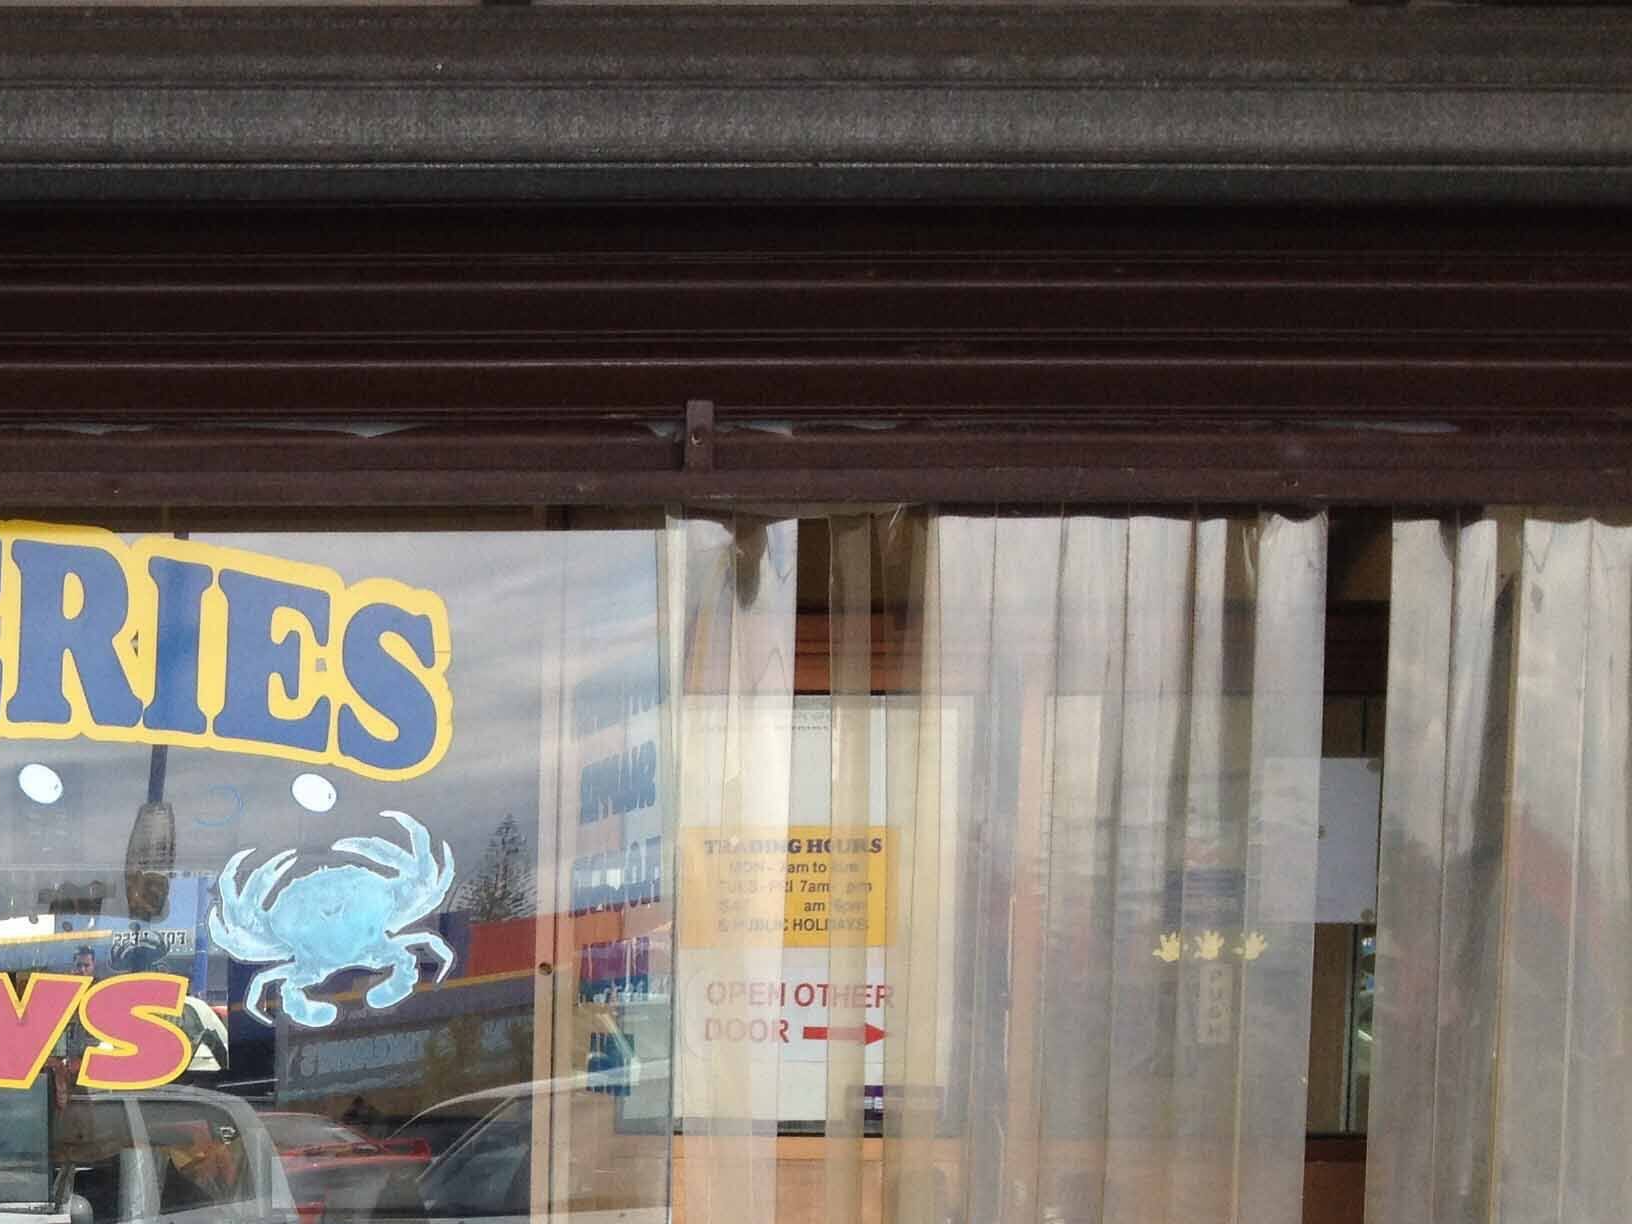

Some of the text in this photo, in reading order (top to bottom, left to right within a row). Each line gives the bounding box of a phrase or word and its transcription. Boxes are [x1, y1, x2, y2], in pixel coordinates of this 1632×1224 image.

[806, 838, 884, 855] HOURS
[706, 980, 895, 1009] OPEN OTHER
[705, 1018, 790, 1044] DOOR
